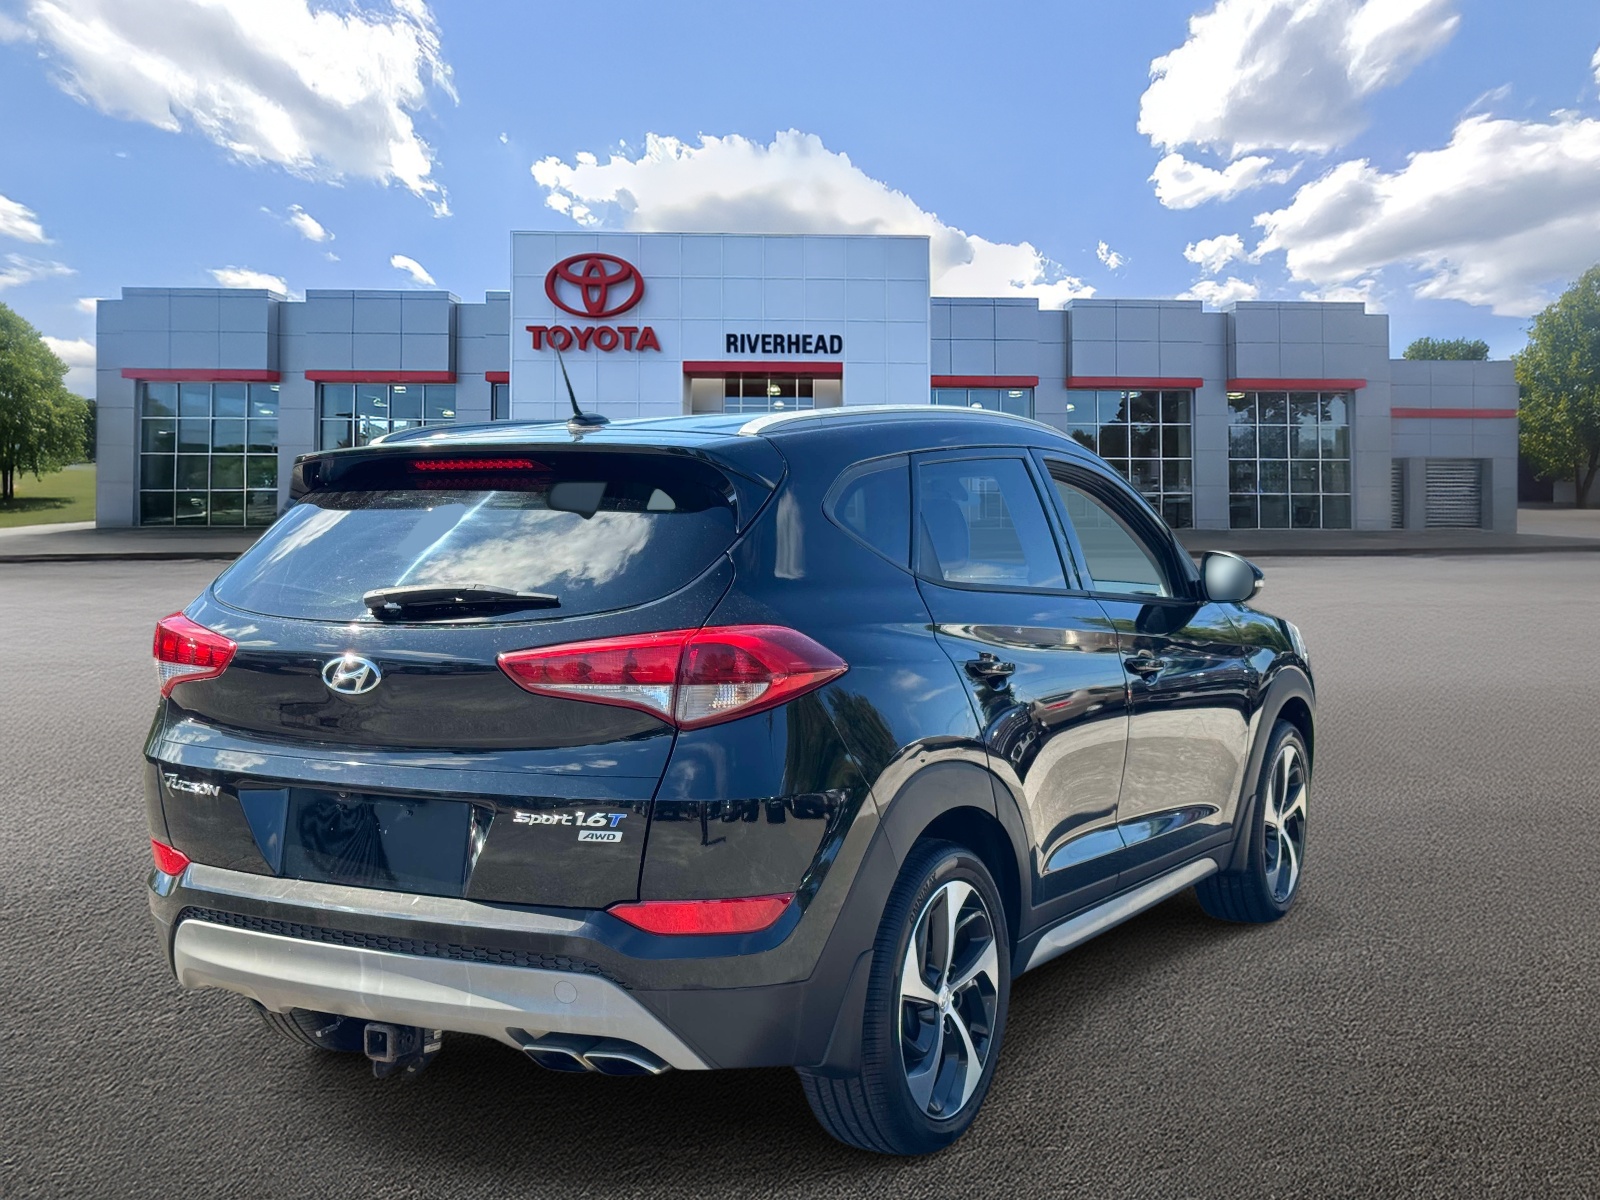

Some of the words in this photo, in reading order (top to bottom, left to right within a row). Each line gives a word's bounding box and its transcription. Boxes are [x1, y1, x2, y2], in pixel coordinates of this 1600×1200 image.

[526, 326, 661, 352] TOYOTA
[726, 333, 843, 355] RIVERHEAD
[513, 811, 573, 826] Sport
[582, 833, 616, 841] AWD
